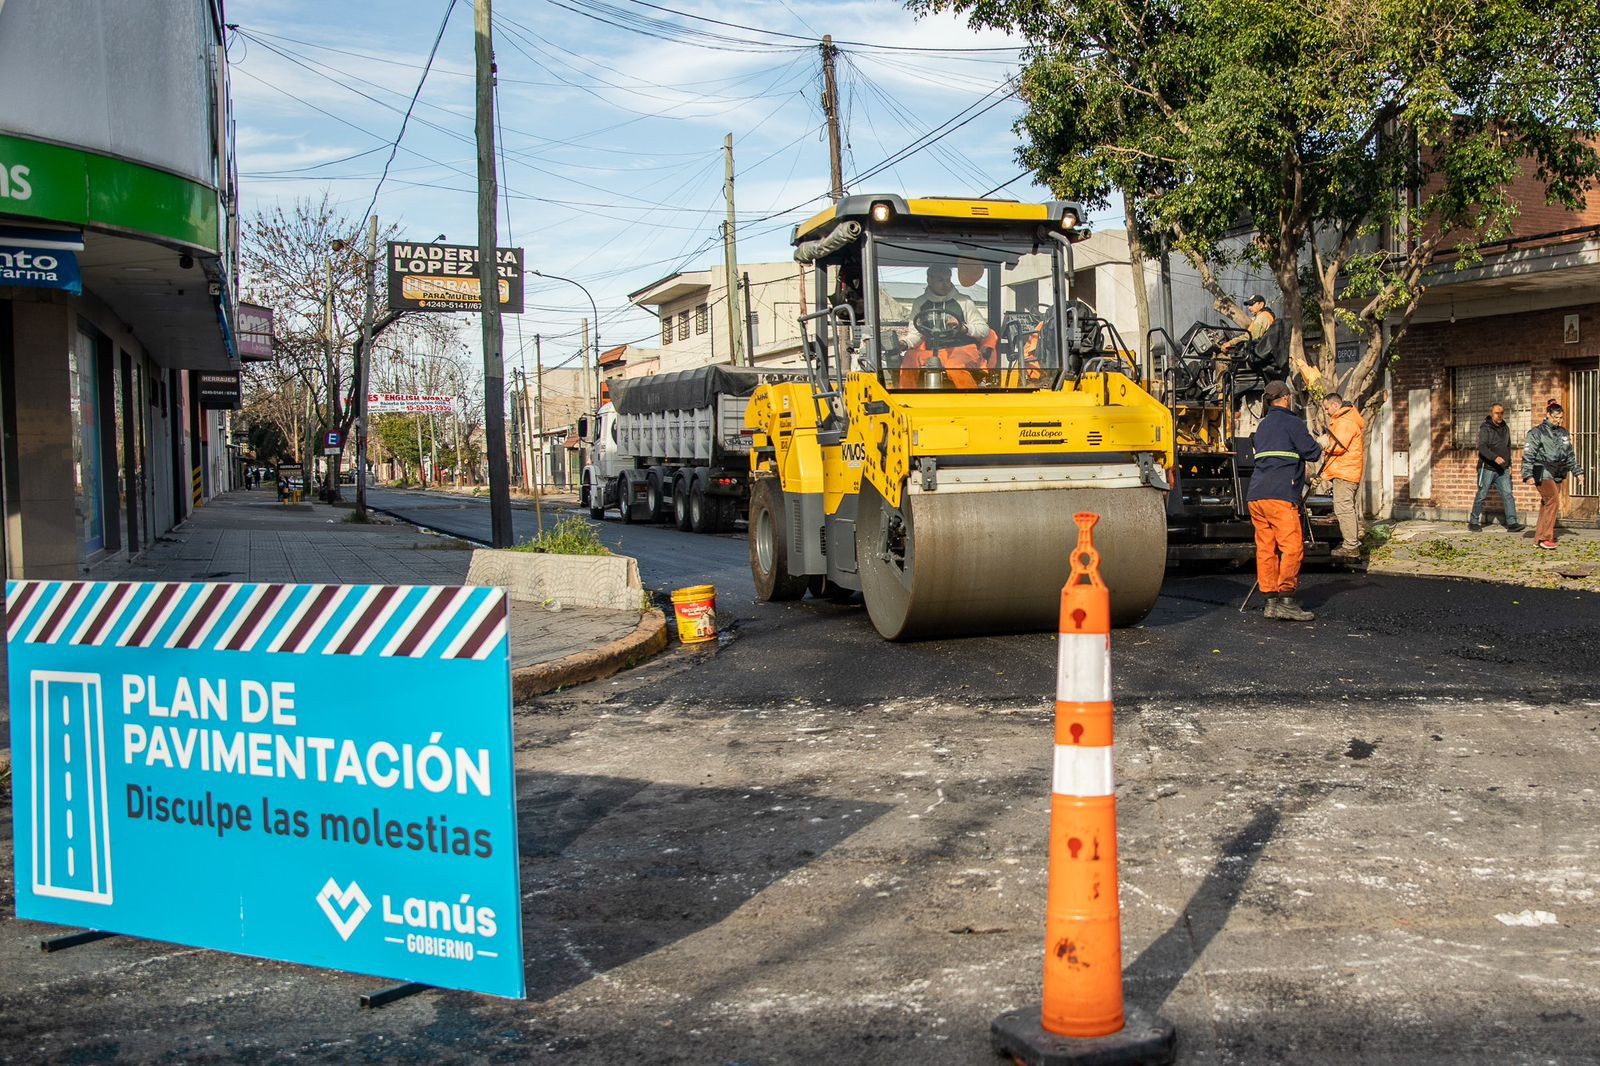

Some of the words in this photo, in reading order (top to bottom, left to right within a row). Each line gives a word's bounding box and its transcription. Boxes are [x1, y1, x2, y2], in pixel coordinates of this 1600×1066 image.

[394, 245, 518, 264] MADERA
[394, 259, 473, 275] LOPEZ
[406, 278, 507, 295] HERRAJS
[423, 292, 445, 300] PARA
[328, 433, 337, 445] E
[122, 674, 228, 721] PLAN
[240, 680, 297, 726] DE
[123, 723, 492, 796] PAVIMENTACIÓN
[126, 784, 252, 837] Disculpe
[262, 797, 310, 838] las
[320, 808, 493, 859] molestias
[382, 894, 497, 938] Lanús
[407, 933, 474, 962] GOBIERNO
